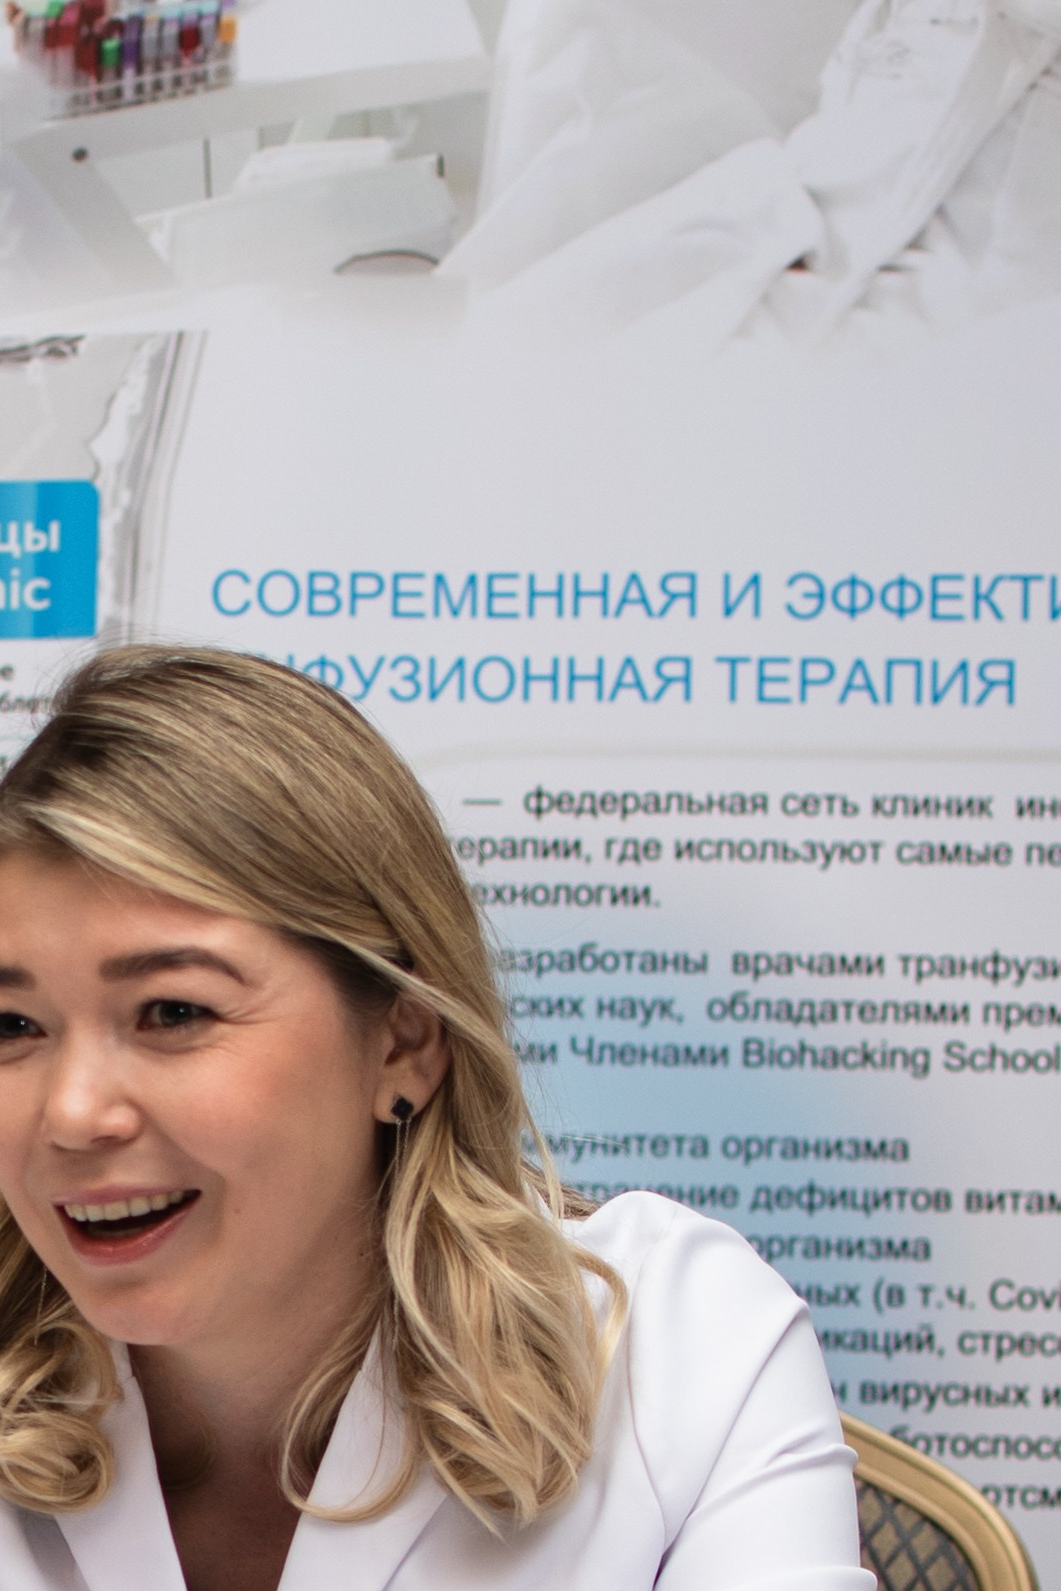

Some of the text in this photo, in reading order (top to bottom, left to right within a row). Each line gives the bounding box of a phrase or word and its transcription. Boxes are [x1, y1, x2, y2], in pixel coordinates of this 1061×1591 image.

[211, 569, 698, 620] СОВРЕМЕННАЯ
[722, 572, 762, 620] И
[258, 654, 1017, 706] ФУЗИОННАЯ ТЕРАПИЯ
[522, 784, 769, 821] федеральная
[780, 792, 860, 818] сеть
[871, 793, 994, 819] клиник
[1015, 795, 1061, 819] ин
[454, 836, 592, 866] ерапии,
[604, 837, 663, 866] где
[675, 837, 885, 871] используют
[895, 840, 1014, 867] самые
[472, 882, 662, 908] ехнологии.
[498, 942, 708, 979] азработаны
[731, 950, 886, 983] врачами
[510, 995, 585, 1020] ских
[595, 995, 685, 1028] наук,
[706, 990, 970, 1028] обладателями
[513, 1034, 1061, 1079] ми Членами Biohacking School
[721, 1135, 910, 1166] организма
[748, 1177, 953, 1219] дефицитов
[872, 1277, 907, 1316] (в
[957, 1330, 1061, 1364] стрес
[859, 1380, 1031, 1413] вирусных
